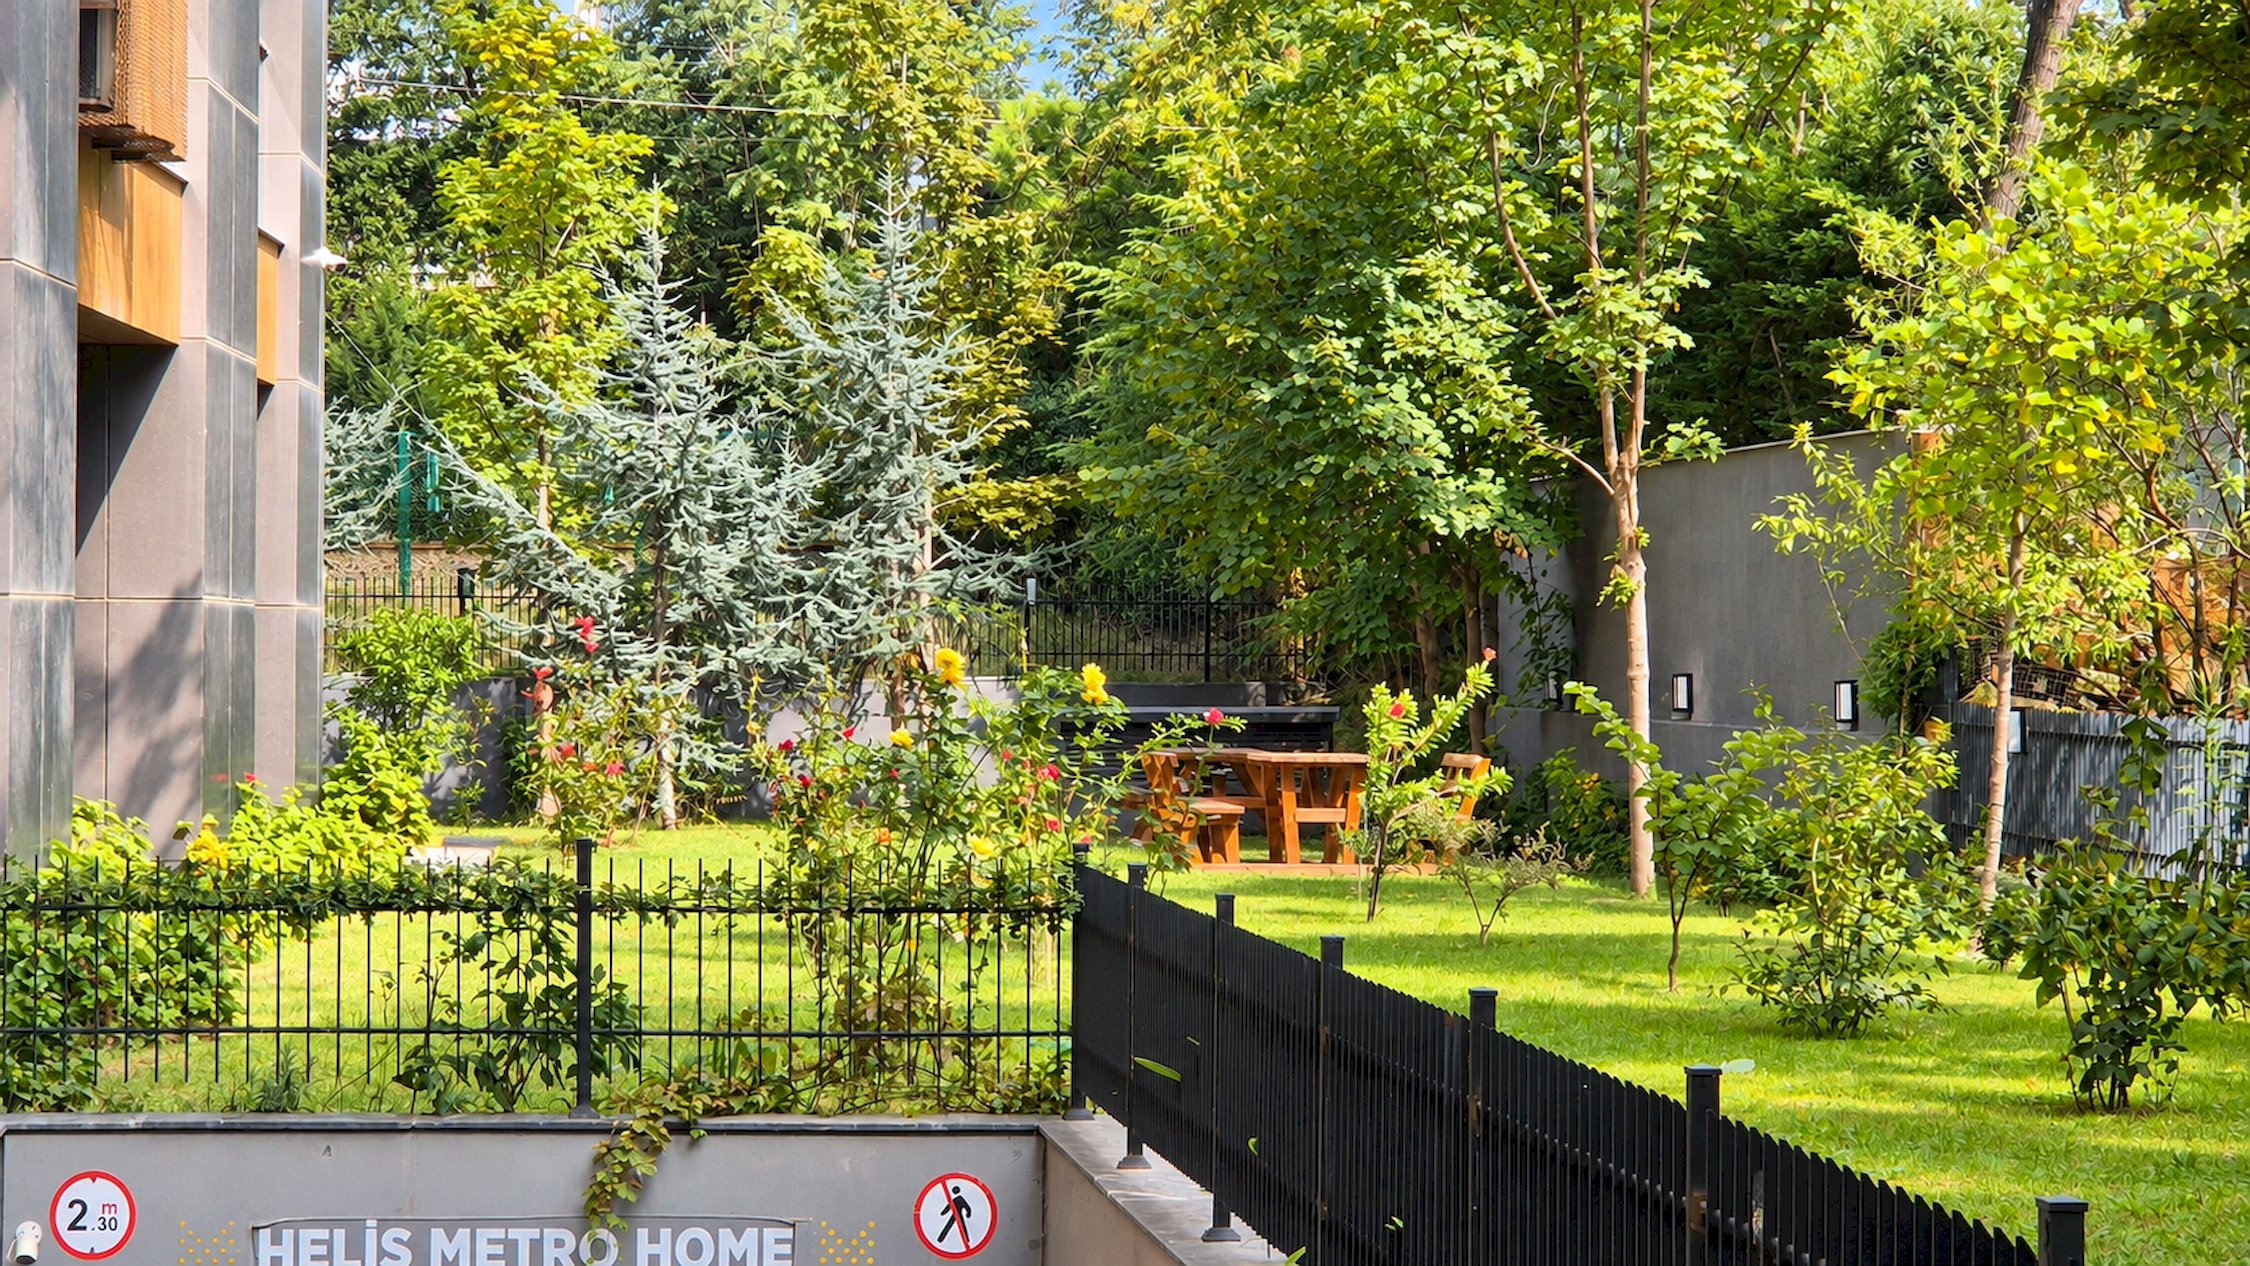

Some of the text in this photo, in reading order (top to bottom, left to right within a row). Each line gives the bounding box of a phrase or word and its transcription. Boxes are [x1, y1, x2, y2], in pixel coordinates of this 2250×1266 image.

[102, 1203, 117, 1214] m
[430, 1228, 619, 1266] METRO
[637, 1227, 793, 1266] HOME
